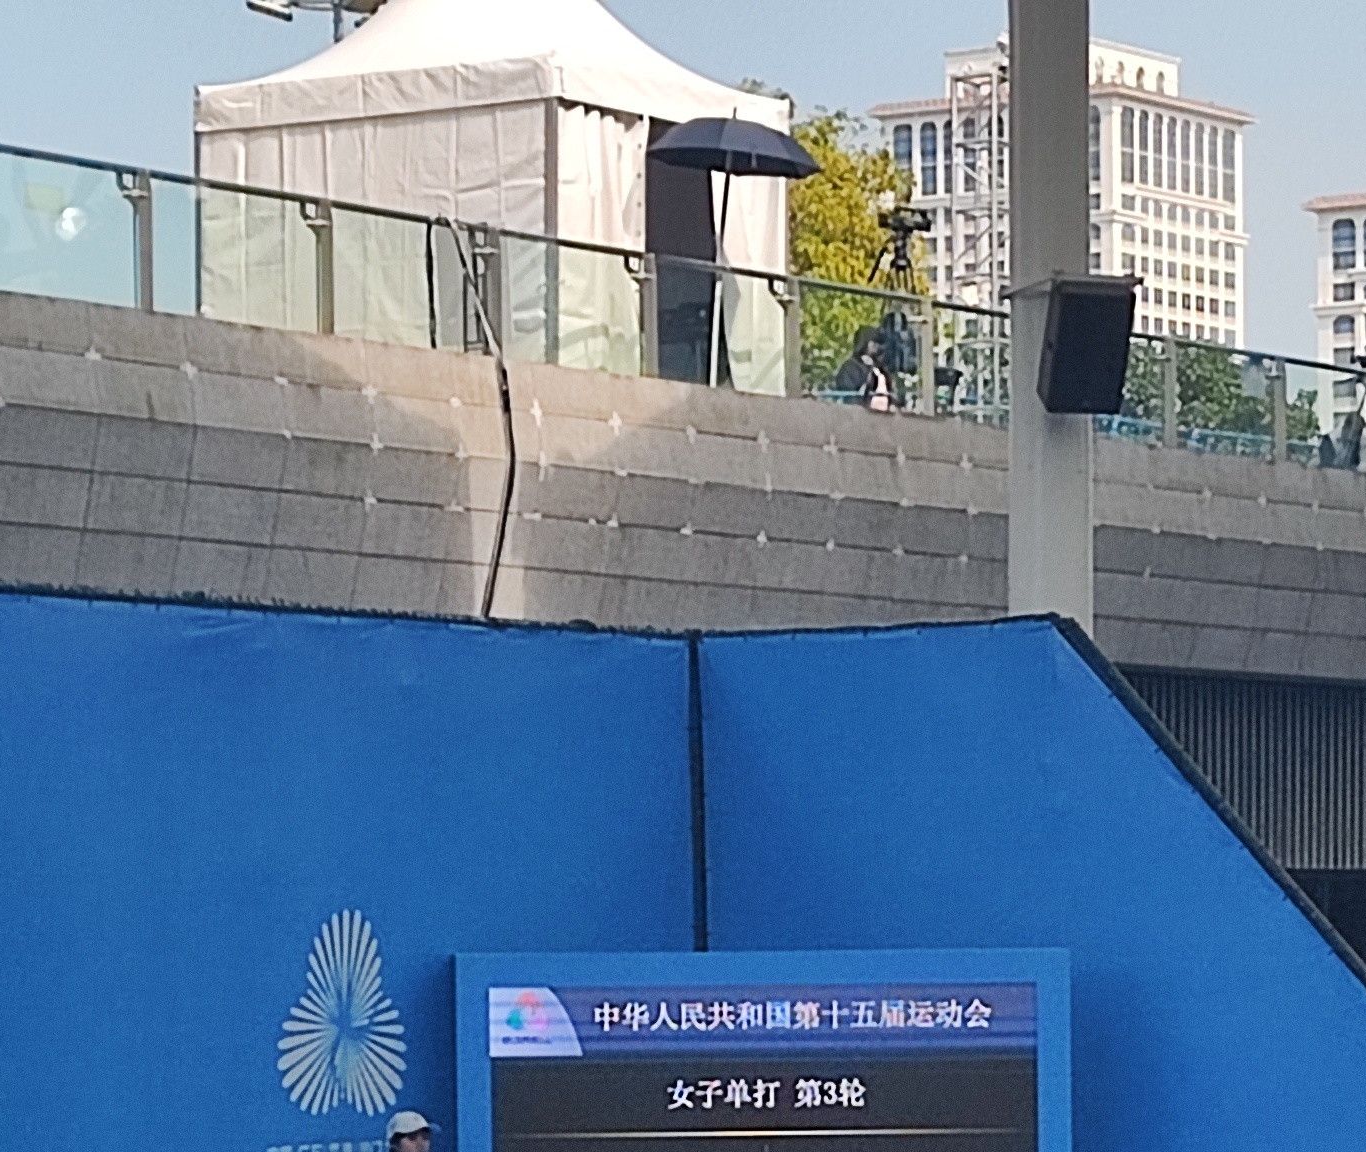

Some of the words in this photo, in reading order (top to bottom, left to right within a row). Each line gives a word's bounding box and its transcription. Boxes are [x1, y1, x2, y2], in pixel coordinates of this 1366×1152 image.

[593, 998, 993, 1031] 中华人民共和国第十五届运动会
[666, 1079, 781, 1110] 女子单打
[793, 1078, 867, 1108] 第3轮
